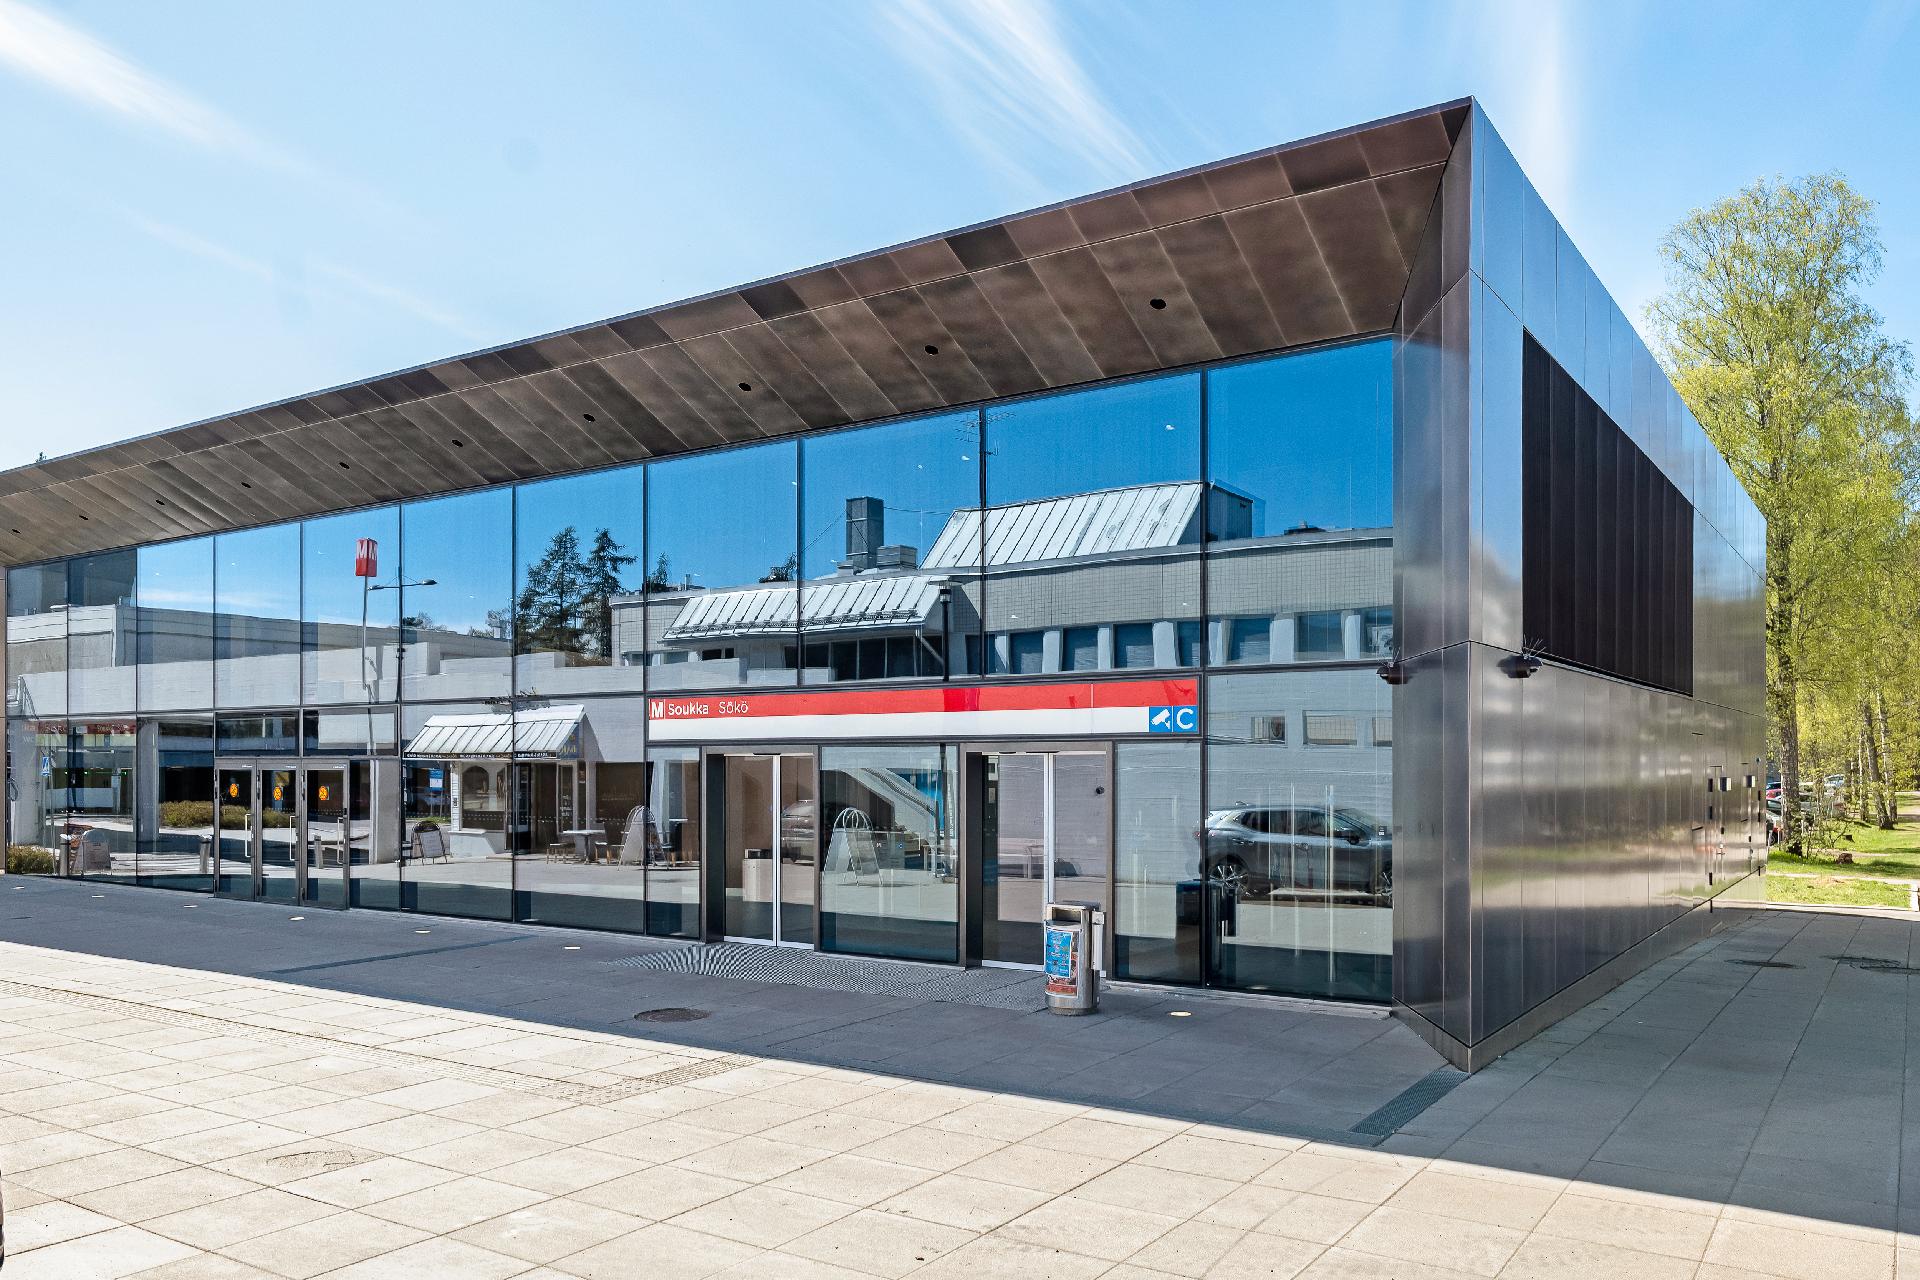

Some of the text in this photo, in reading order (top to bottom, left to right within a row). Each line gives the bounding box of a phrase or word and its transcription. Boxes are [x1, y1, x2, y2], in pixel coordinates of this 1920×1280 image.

[651, 701, 749, 718] M Soukka Sökö
[1176, 708, 1194, 730] C
